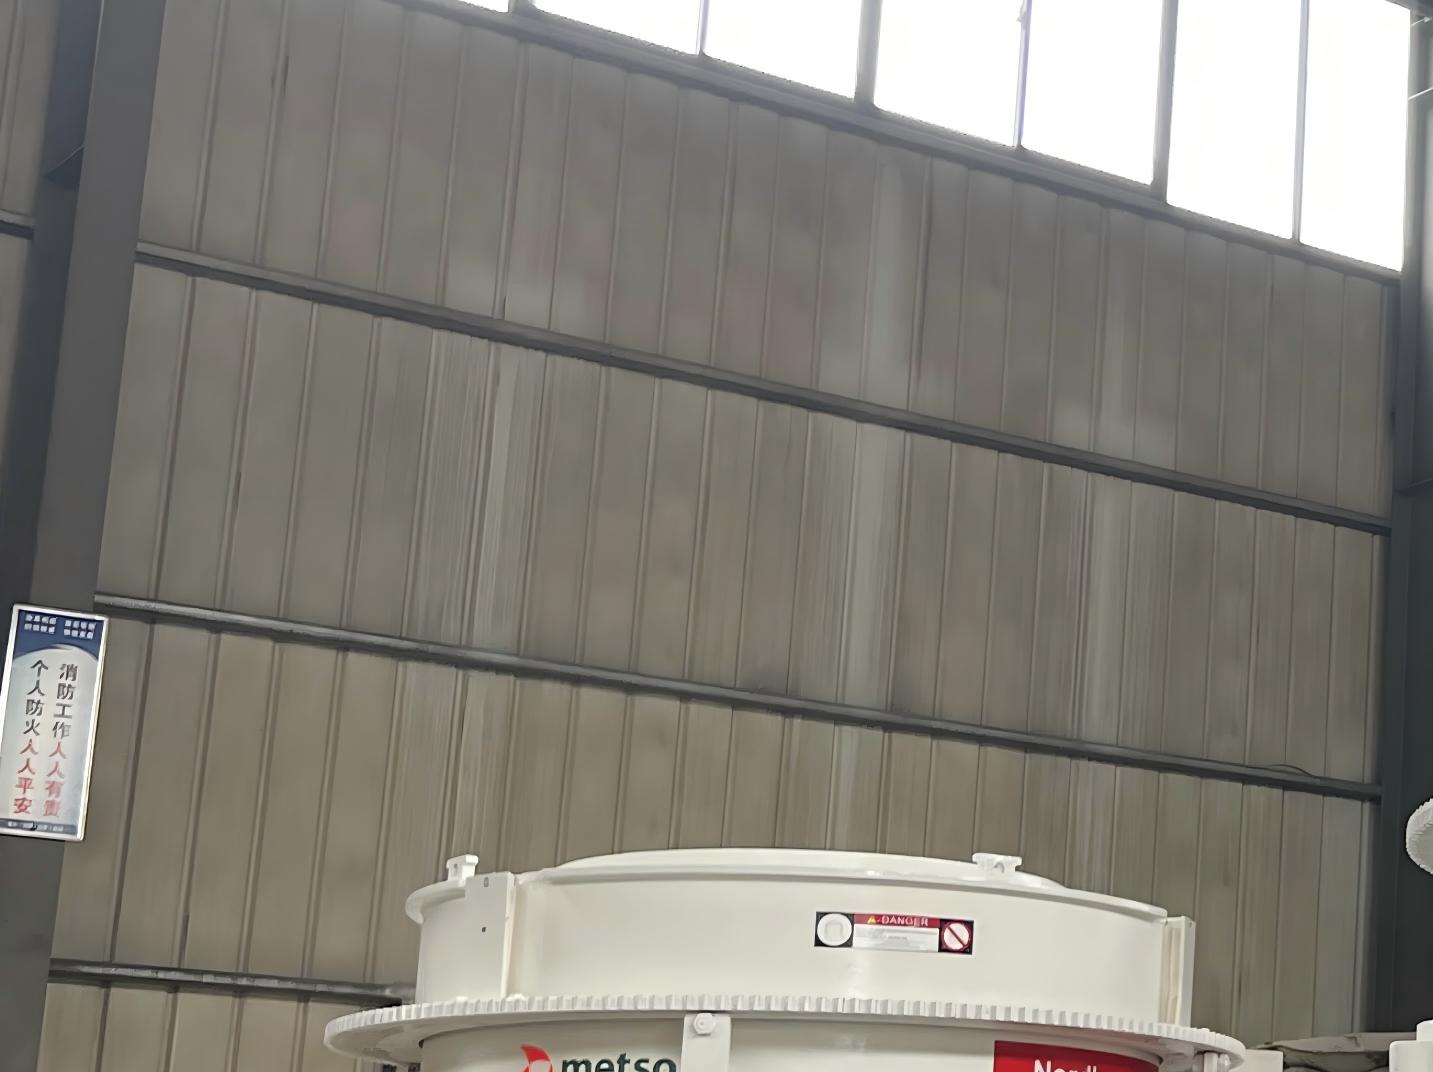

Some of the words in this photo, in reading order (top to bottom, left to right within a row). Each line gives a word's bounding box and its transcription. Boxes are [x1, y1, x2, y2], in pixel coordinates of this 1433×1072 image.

[13, 659, 49, 815] 个人防火人人平安
[881, 914, 929, 927] DANGER
